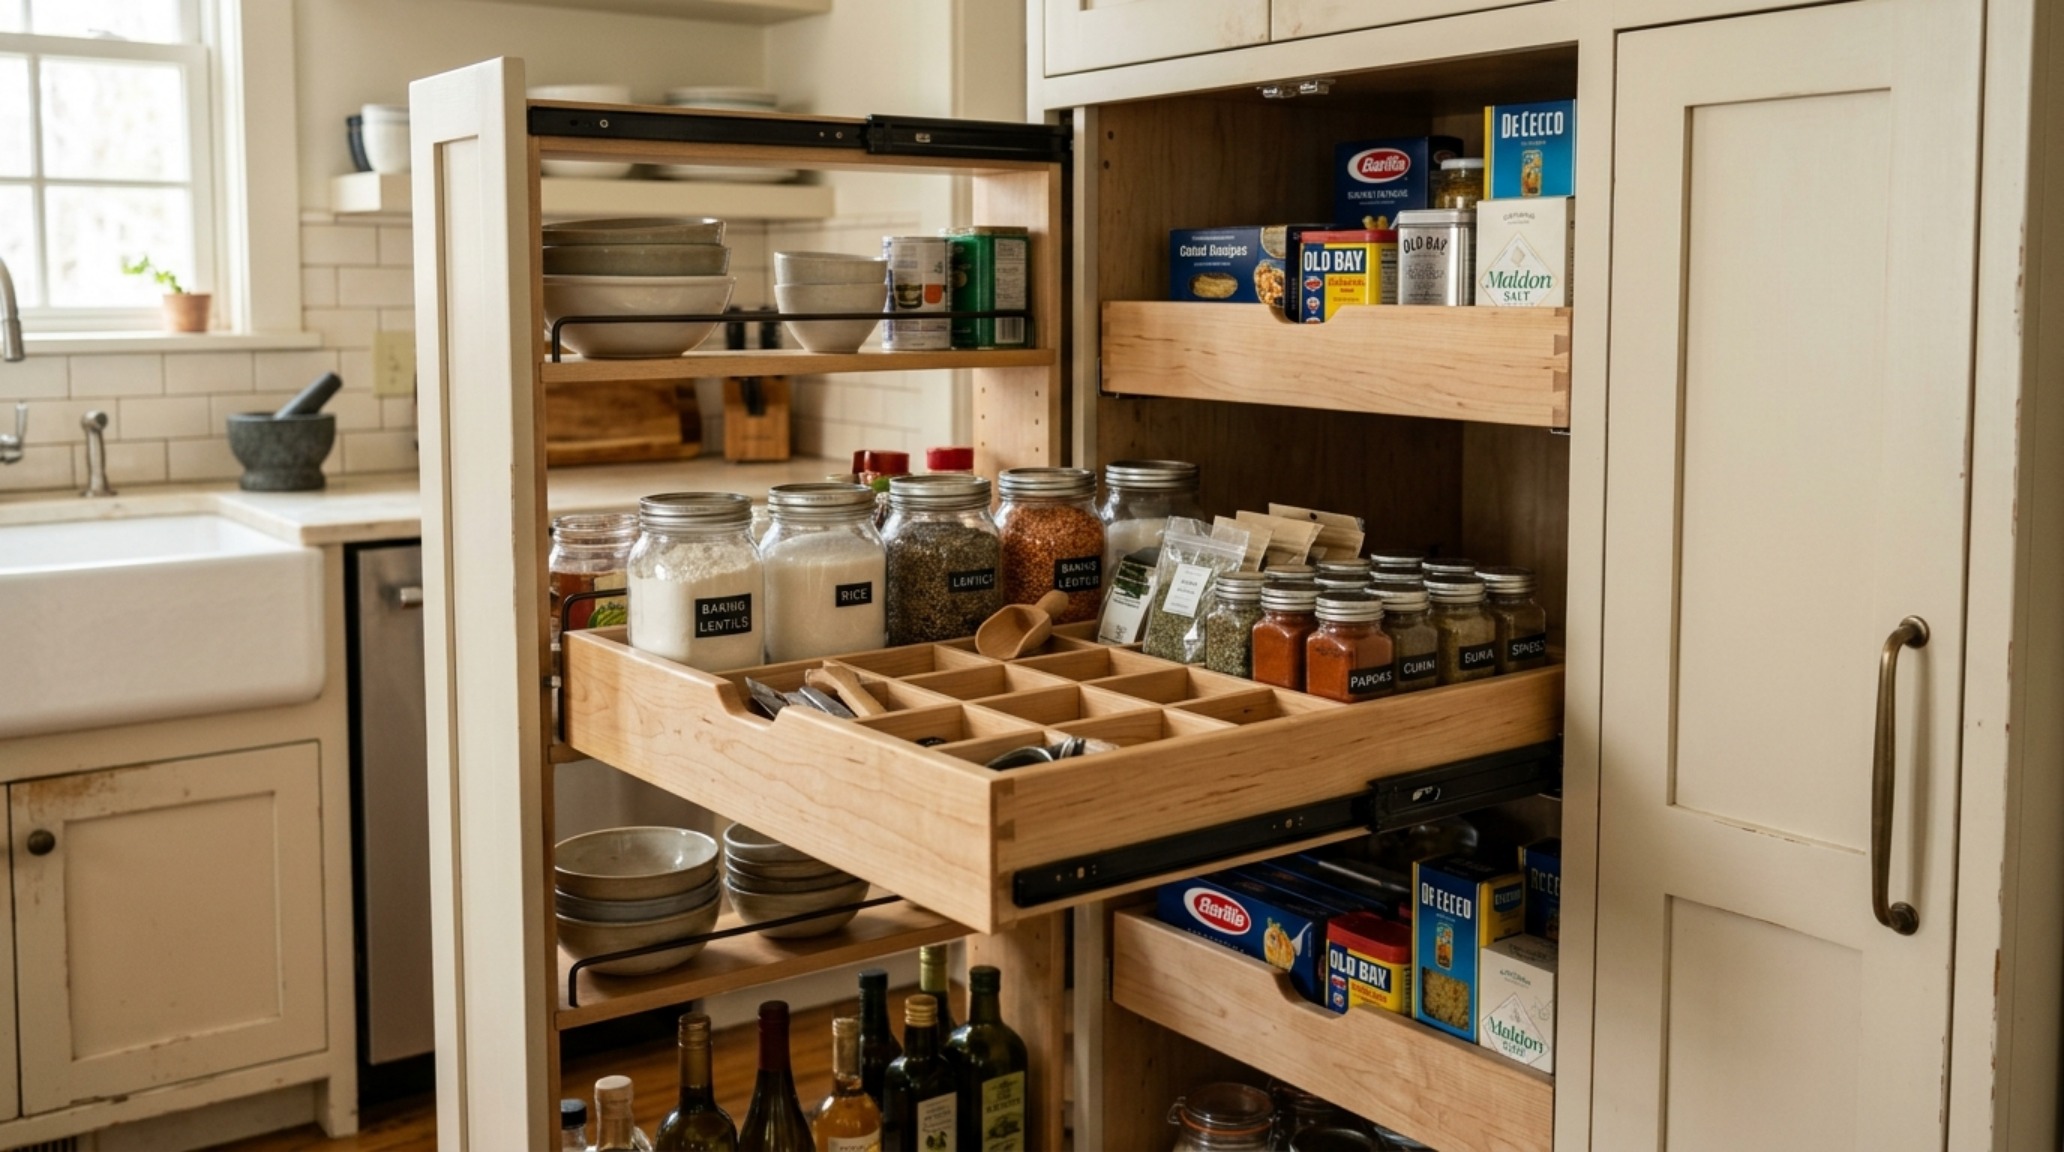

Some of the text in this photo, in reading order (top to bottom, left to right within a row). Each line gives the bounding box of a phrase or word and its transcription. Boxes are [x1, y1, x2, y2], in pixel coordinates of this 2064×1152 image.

[1403, 236, 1424, 254] OLD
[1304, 250, 1363, 272] OLD BAY
[1485, 270, 1552, 289] Maldon
[841, 588, 868, 601] RICE
[700, 616, 749, 632] LENTILS
[1330, 949, 1357, 977] OLD
